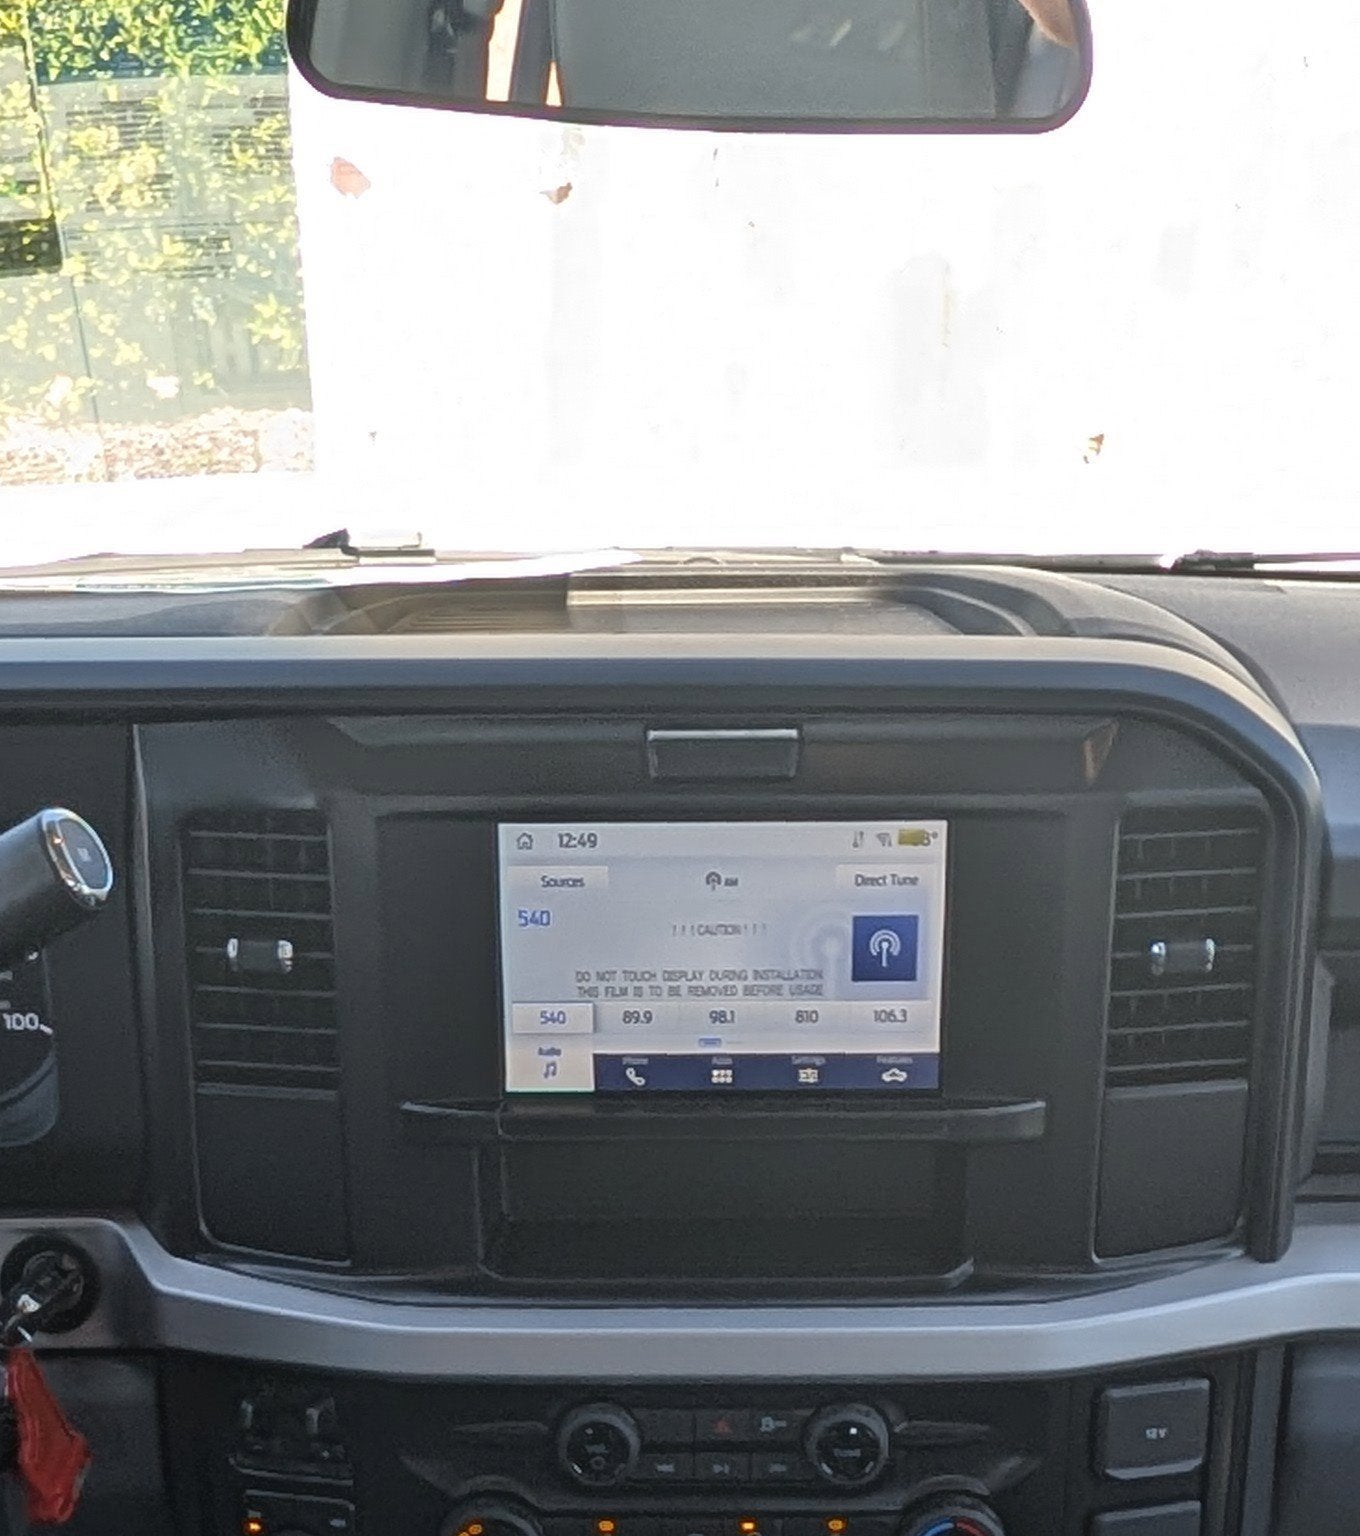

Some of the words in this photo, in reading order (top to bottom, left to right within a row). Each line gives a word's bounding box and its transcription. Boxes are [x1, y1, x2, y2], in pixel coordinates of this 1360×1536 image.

[558, 832, 599, 849] 12:49
[541, 873, 585, 888] Sources
[855, 873, 887, 887] Direct
[891, 873, 920, 887] Tune
[517, 909, 551, 927] 540
[596, 969, 618, 983] NOT
[623, 969, 657, 983] TOUCH
[662, 969, 705, 983] DISPLAY
[710, 969, 748, 983] DURING
[753, 969, 824, 983] INSTALLATION
[577, 985, 600, 998] THIS
[605, 985, 628, 998] FILM
[649, 985, 662, 998] TO
[687, 985, 738, 998] REMOVED
[743, 985, 784, 998] BEFORE
[2, 1012, 39, 1031] 100
[539, 1010, 567, 1025] 540
[622, 1010, 653, 1025] 89.9
[709, 1010, 735, 1025] 98.1
[794, 1010, 819, 1024] 810
[873, 1009, 908, 1024] 106.3
